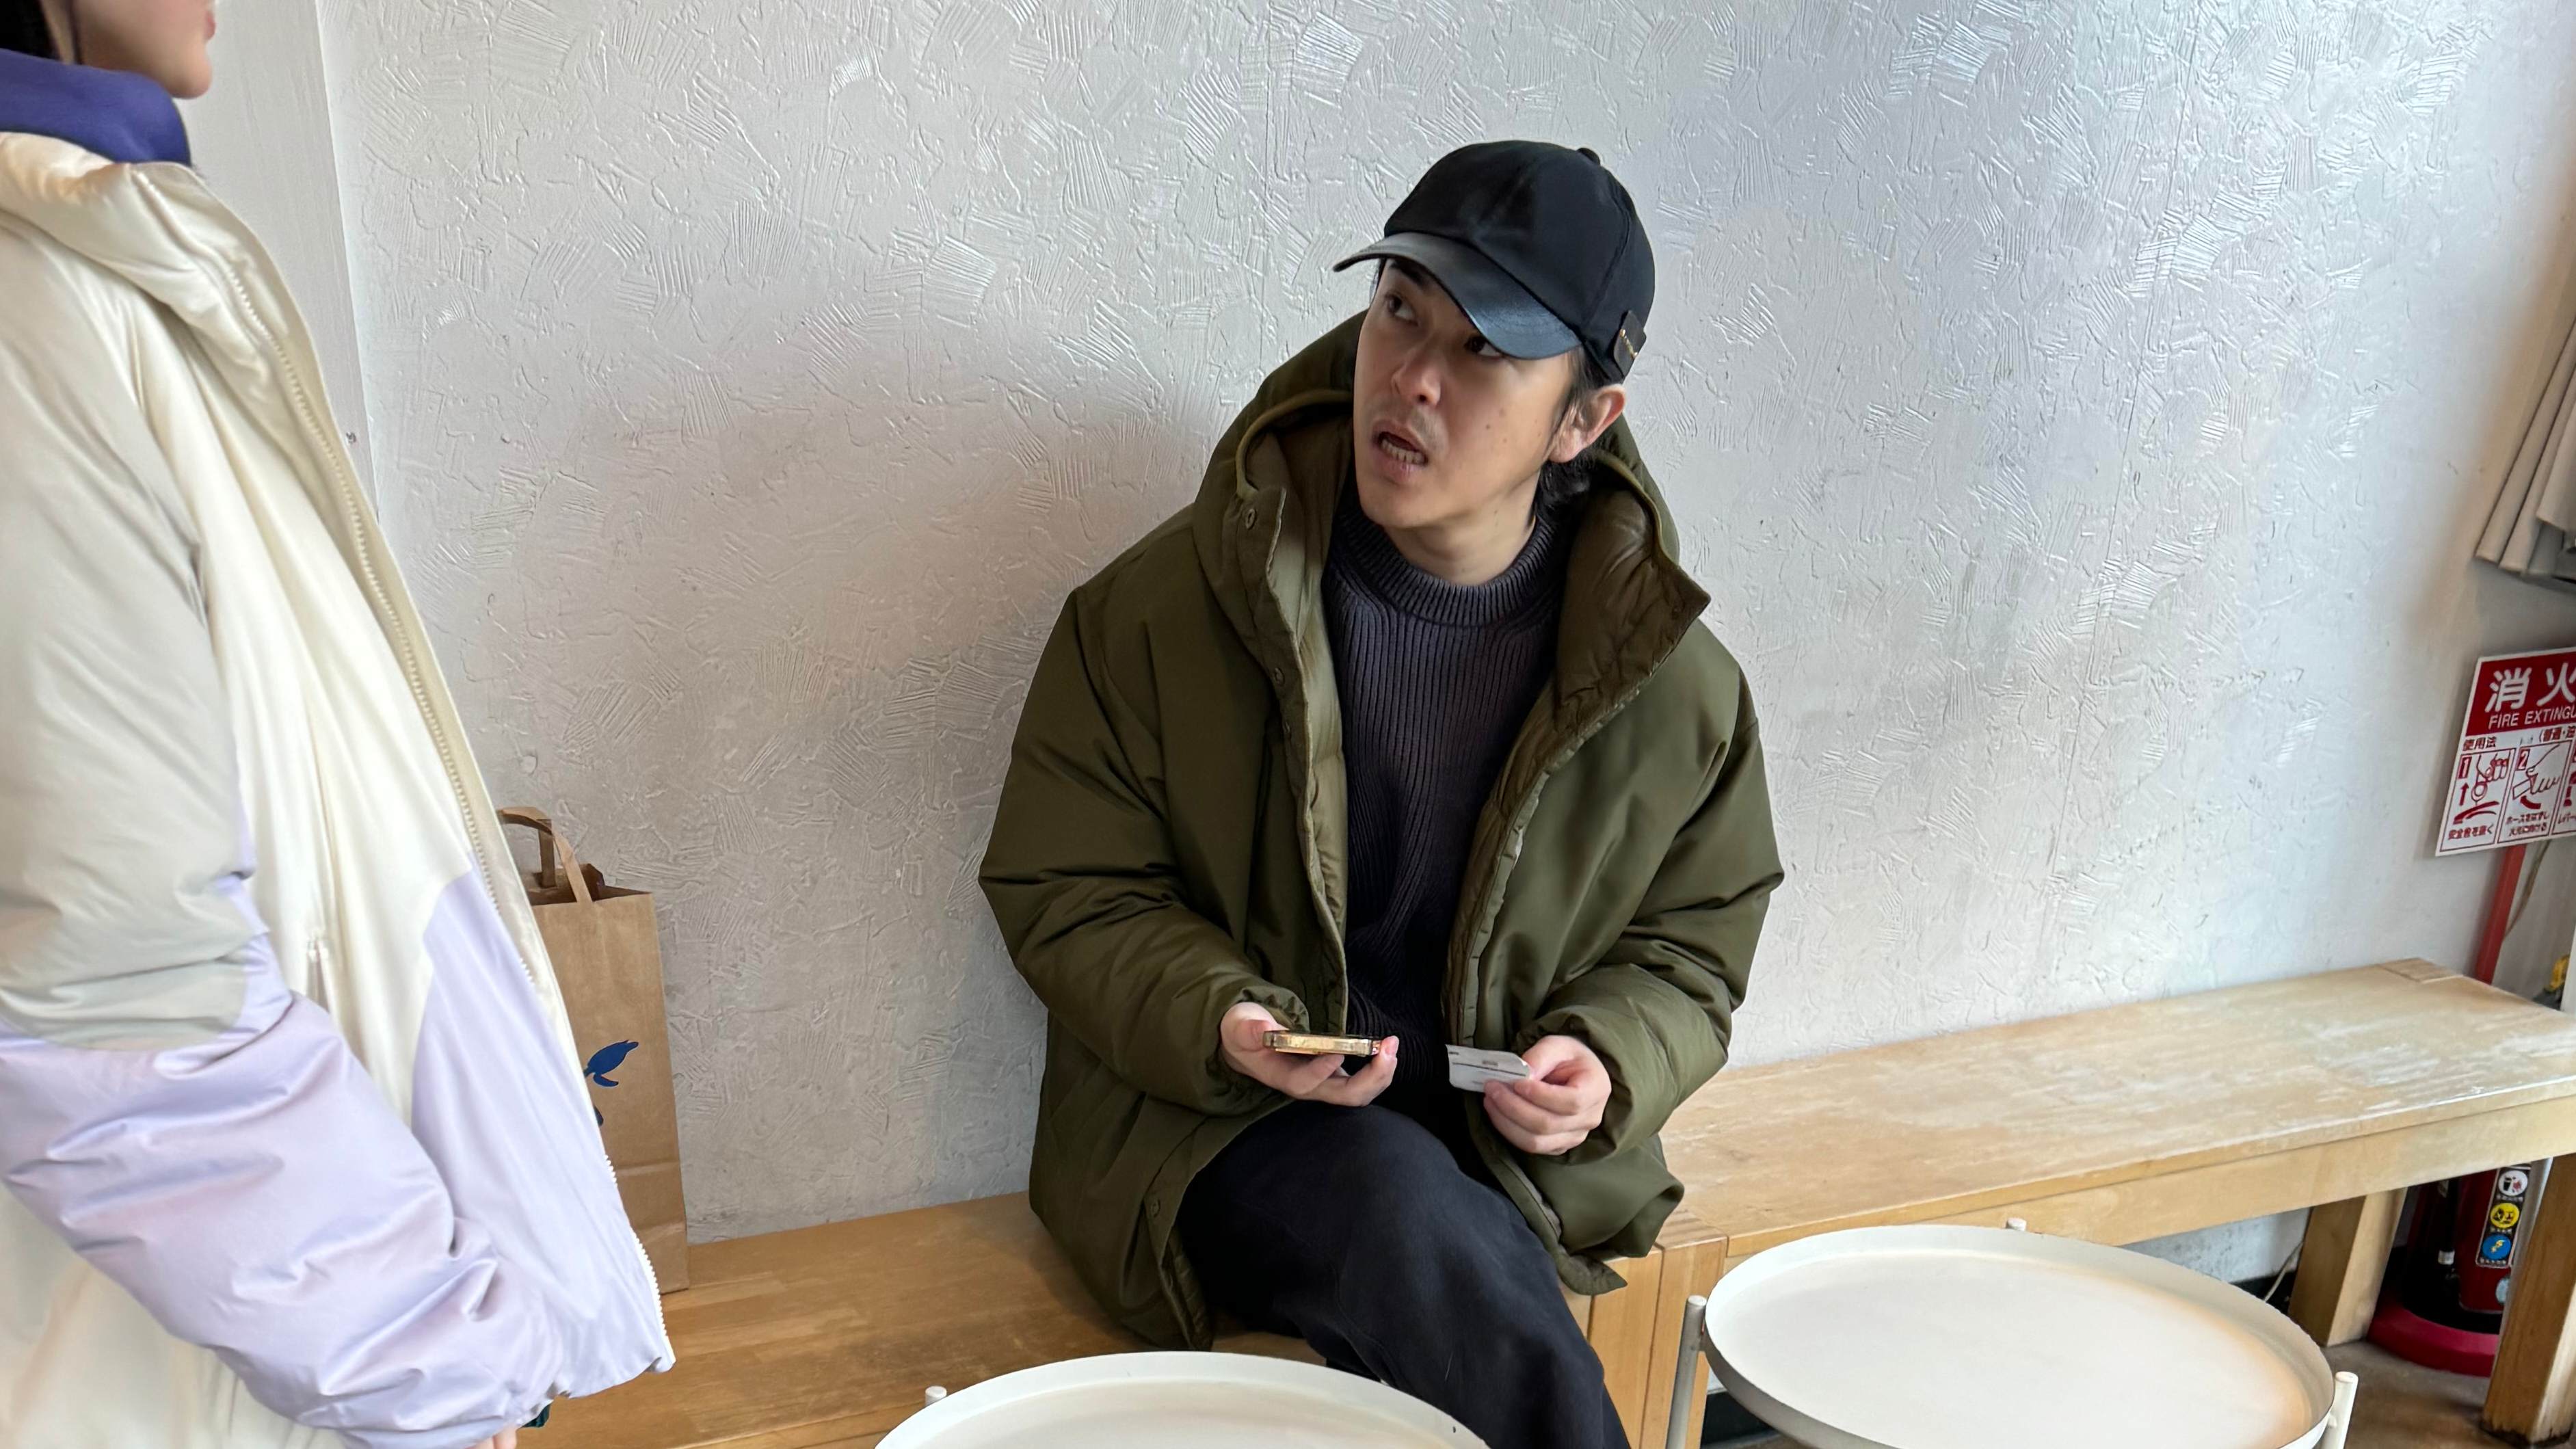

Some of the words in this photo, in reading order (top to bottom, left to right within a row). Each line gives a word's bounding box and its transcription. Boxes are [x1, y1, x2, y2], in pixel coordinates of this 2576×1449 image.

[2484, 662, 2576, 713] 消火
[2488, 712, 2519, 730] FIRE
[2462, 758, 2469, 777] 1
[2519, 751, 2527, 769] 2
